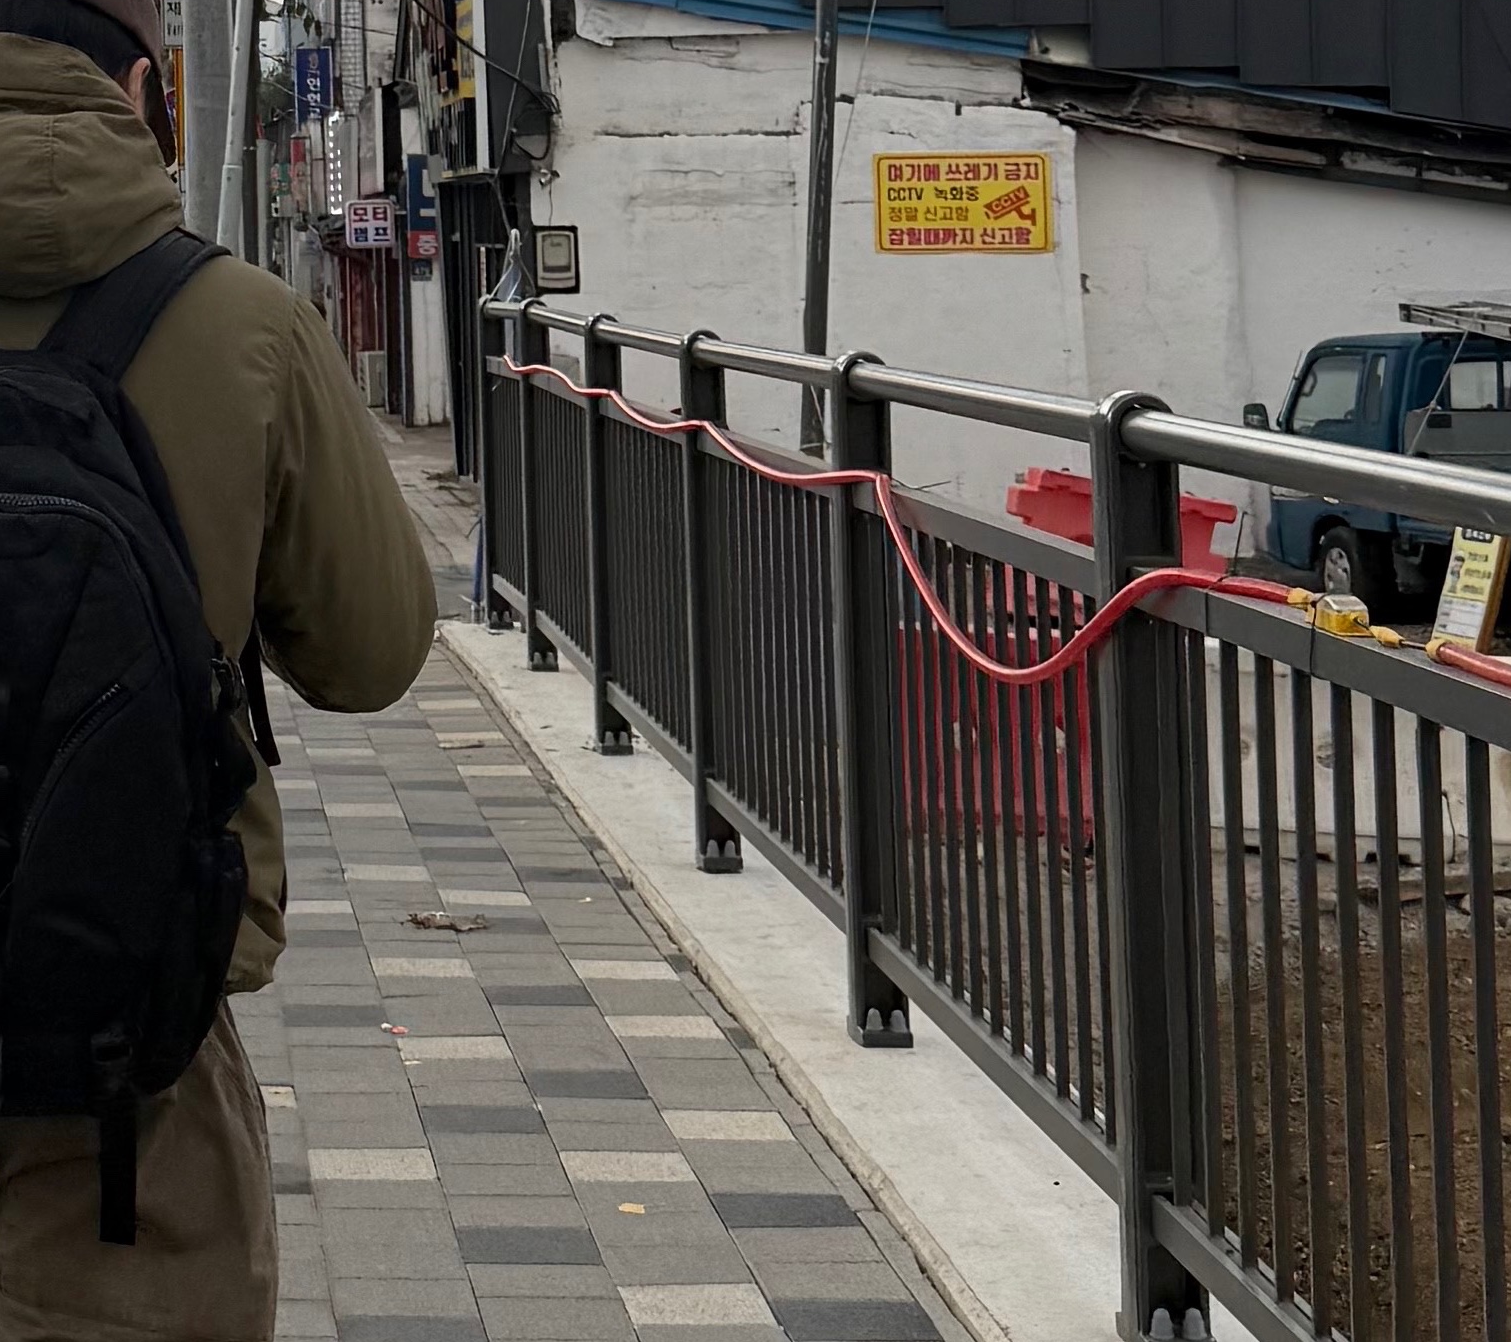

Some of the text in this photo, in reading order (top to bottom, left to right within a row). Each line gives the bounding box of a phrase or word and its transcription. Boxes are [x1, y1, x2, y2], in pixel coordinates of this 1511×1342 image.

[945, 162, 999, 181] 쓰레기
[1004, 161, 1039, 181] 금지
[887, 187, 924, 202] CCTV
[992, 187, 1028, 212] CCTV
[352, 206, 388, 223] 모터
[889, 206, 919, 222] 정말
[353, 226, 390, 243] 펌프
